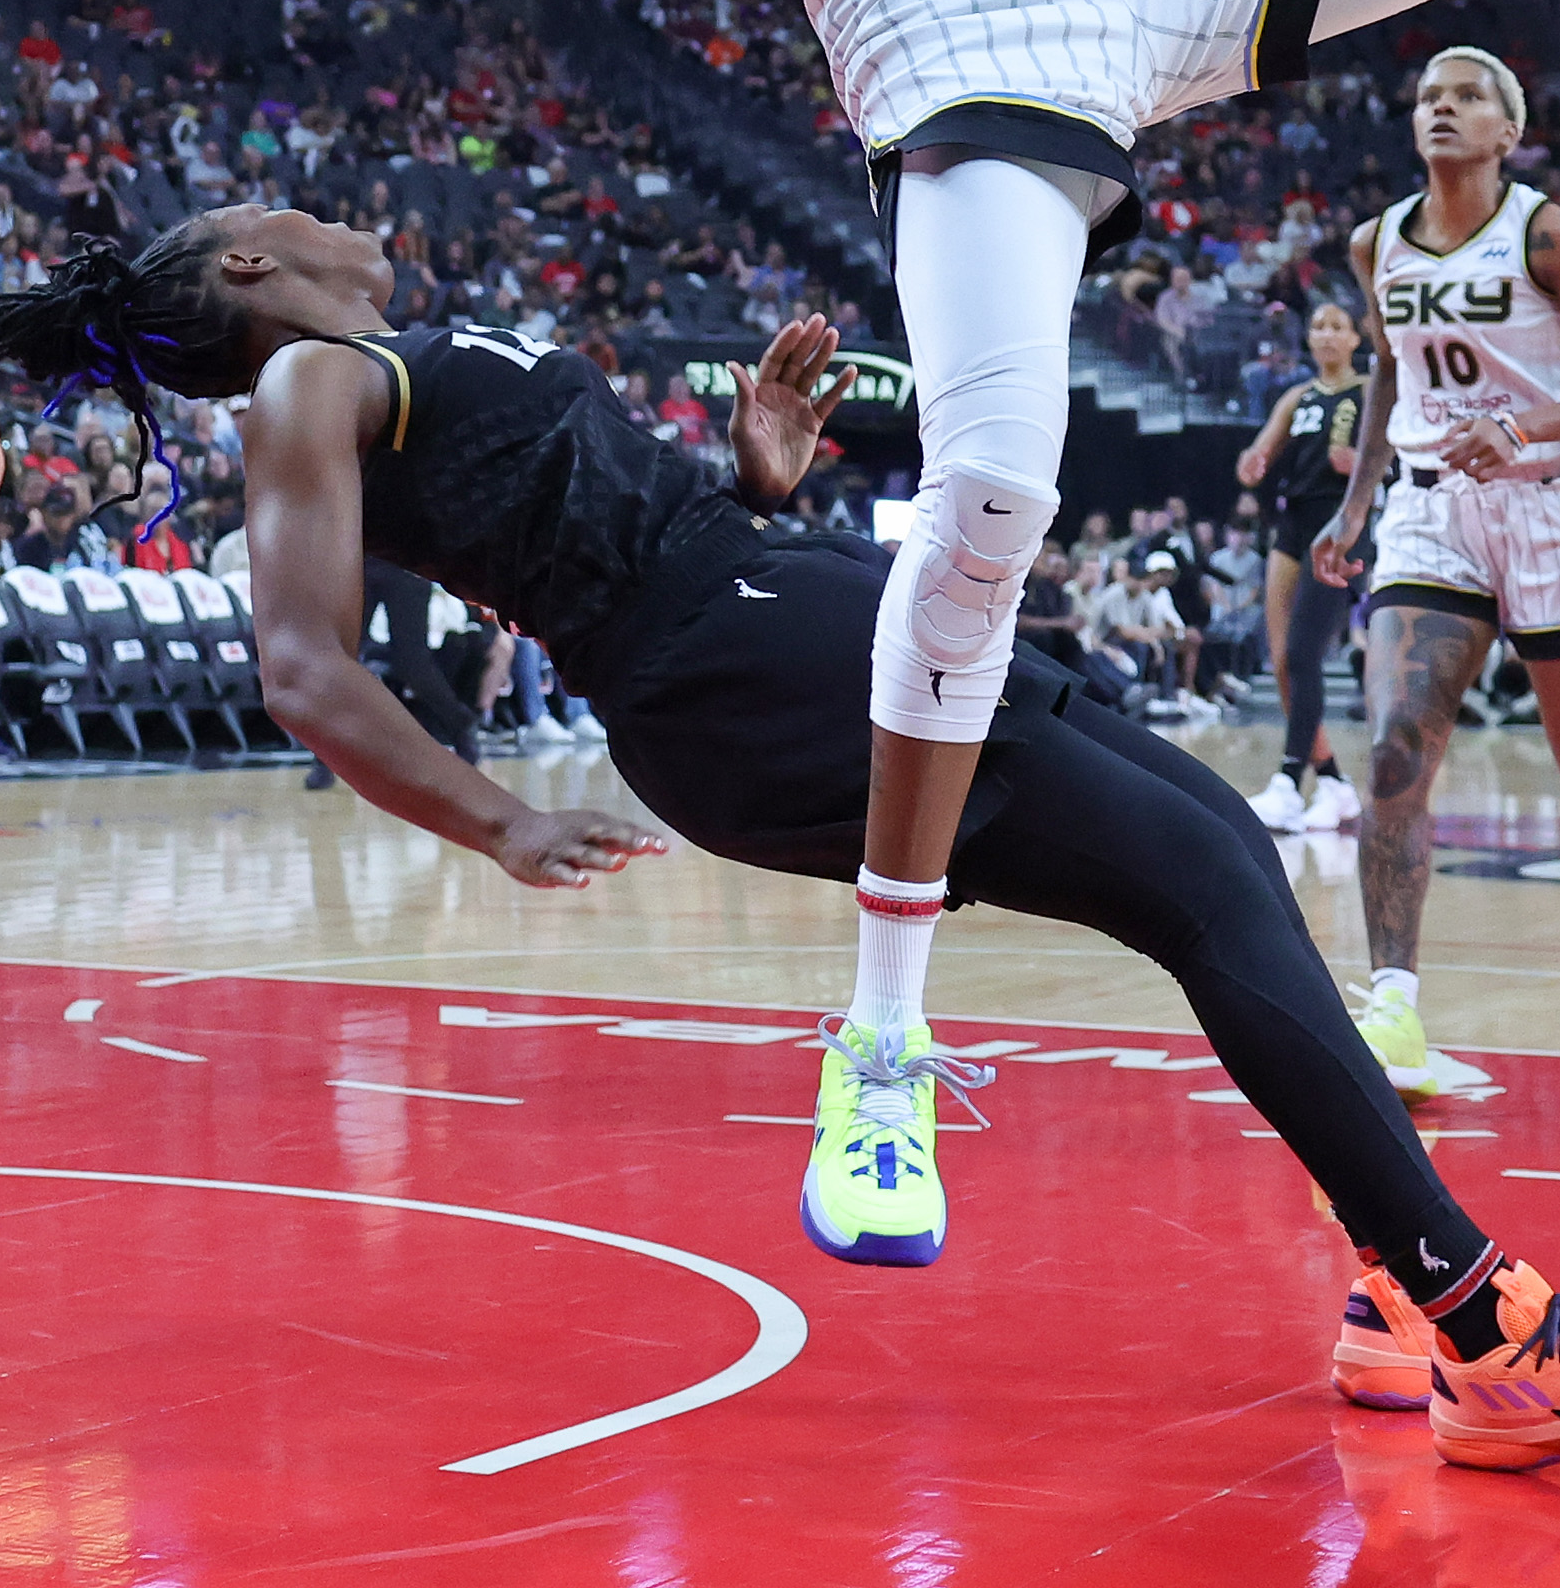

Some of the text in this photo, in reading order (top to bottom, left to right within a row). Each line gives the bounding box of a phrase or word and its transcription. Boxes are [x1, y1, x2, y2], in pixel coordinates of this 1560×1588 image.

[1384, 277, 1513, 326] SKY
[1421, 340, 1479, 389] 10
[1289, 404, 1324, 438] 22
